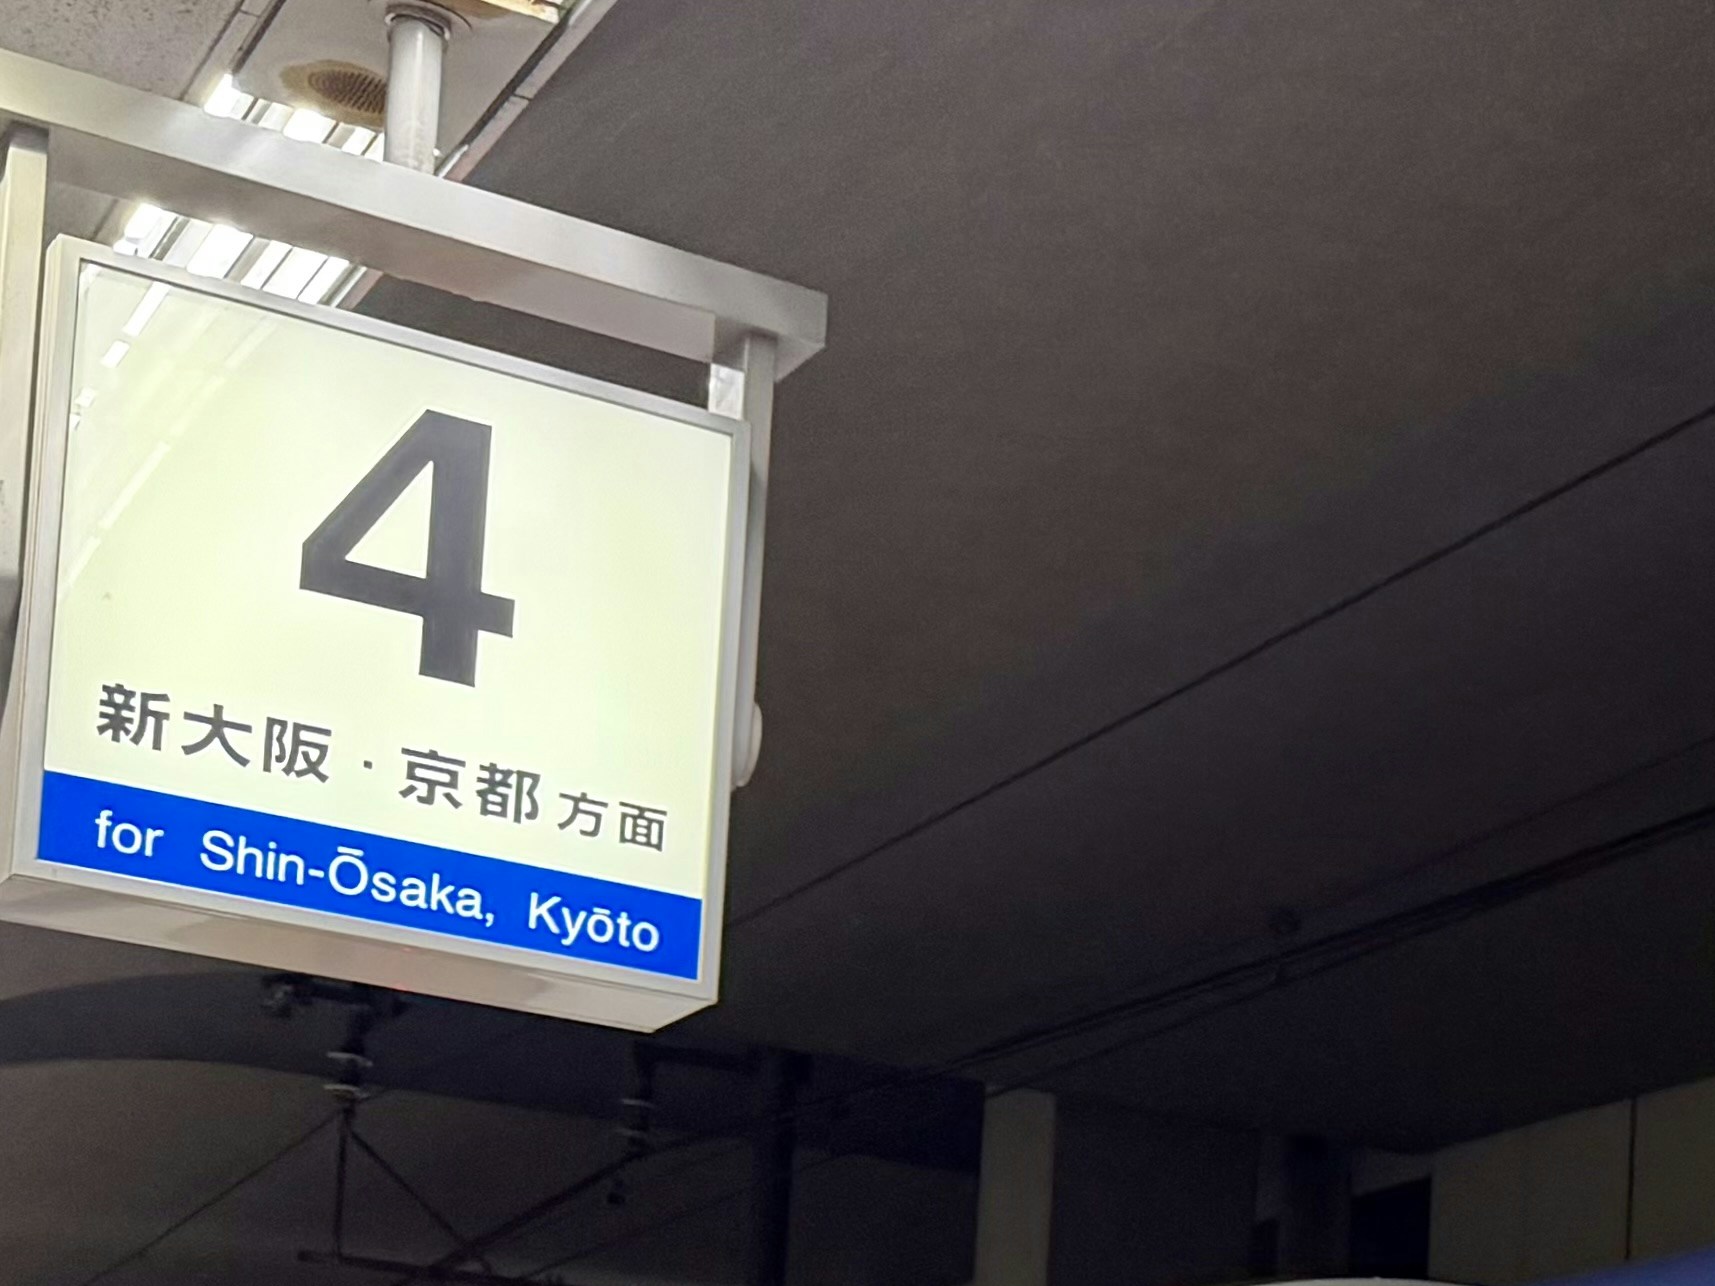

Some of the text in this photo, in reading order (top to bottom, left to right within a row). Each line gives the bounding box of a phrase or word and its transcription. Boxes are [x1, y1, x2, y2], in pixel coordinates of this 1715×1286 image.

[299, 408, 515, 687] 4
[94, 809, 660, 955] for Shin-Ōsaka, Kyōto
